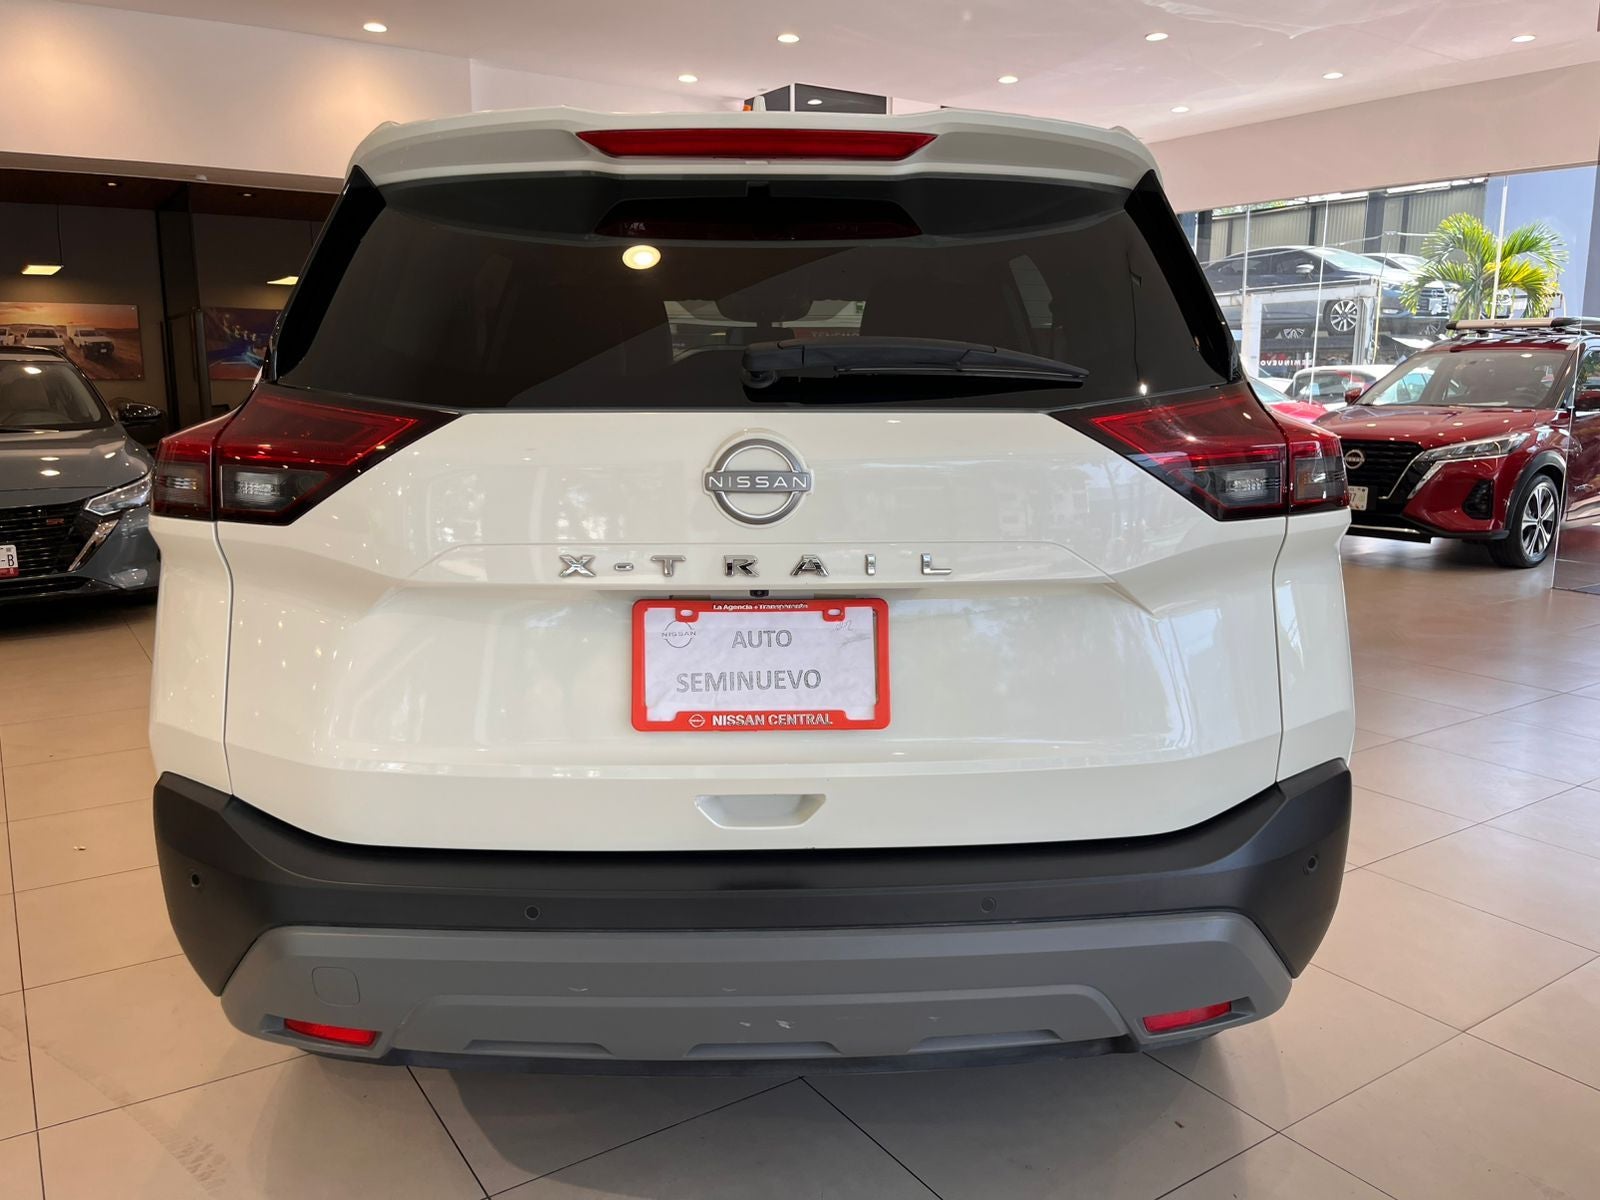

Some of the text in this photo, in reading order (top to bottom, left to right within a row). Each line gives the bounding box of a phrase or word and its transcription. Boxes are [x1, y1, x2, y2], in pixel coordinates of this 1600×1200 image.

[708, 475, 808, 489] NISSAN
[559, 553, 953, 578] X-TRAIL
[723, 603, 753, 612] Agencia
[732, 629, 793, 649] AUTO
[676, 669, 822, 693] SEMINUEVO
[712, 713, 833, 726] NISSAN CENTRAL
